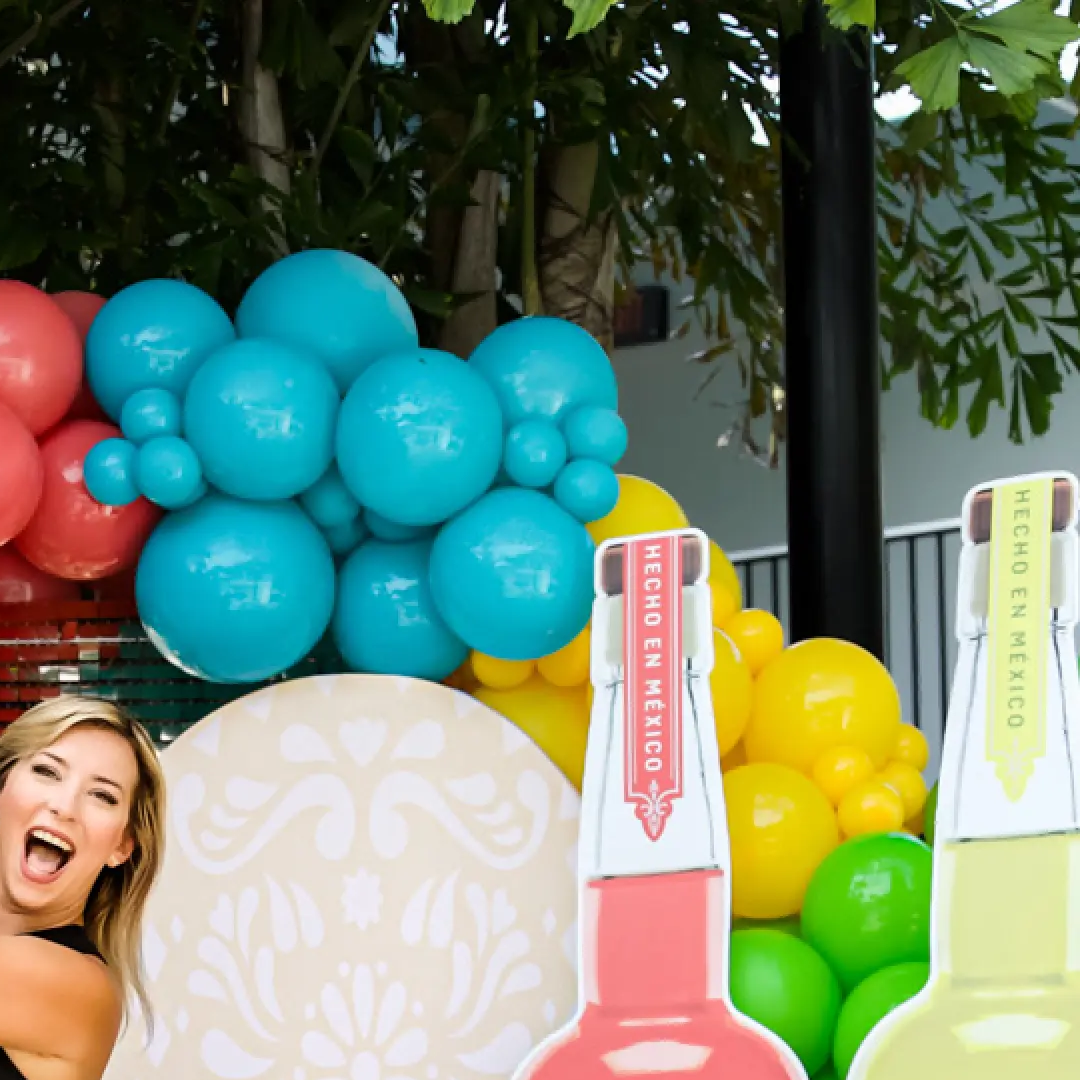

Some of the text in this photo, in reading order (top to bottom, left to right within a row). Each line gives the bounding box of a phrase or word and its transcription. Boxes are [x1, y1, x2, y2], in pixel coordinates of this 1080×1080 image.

[643, 545, 666, 772] HECHO EN MÉXICO
[1007, 489, 1030, 729] HECHO EN MÉXICO
